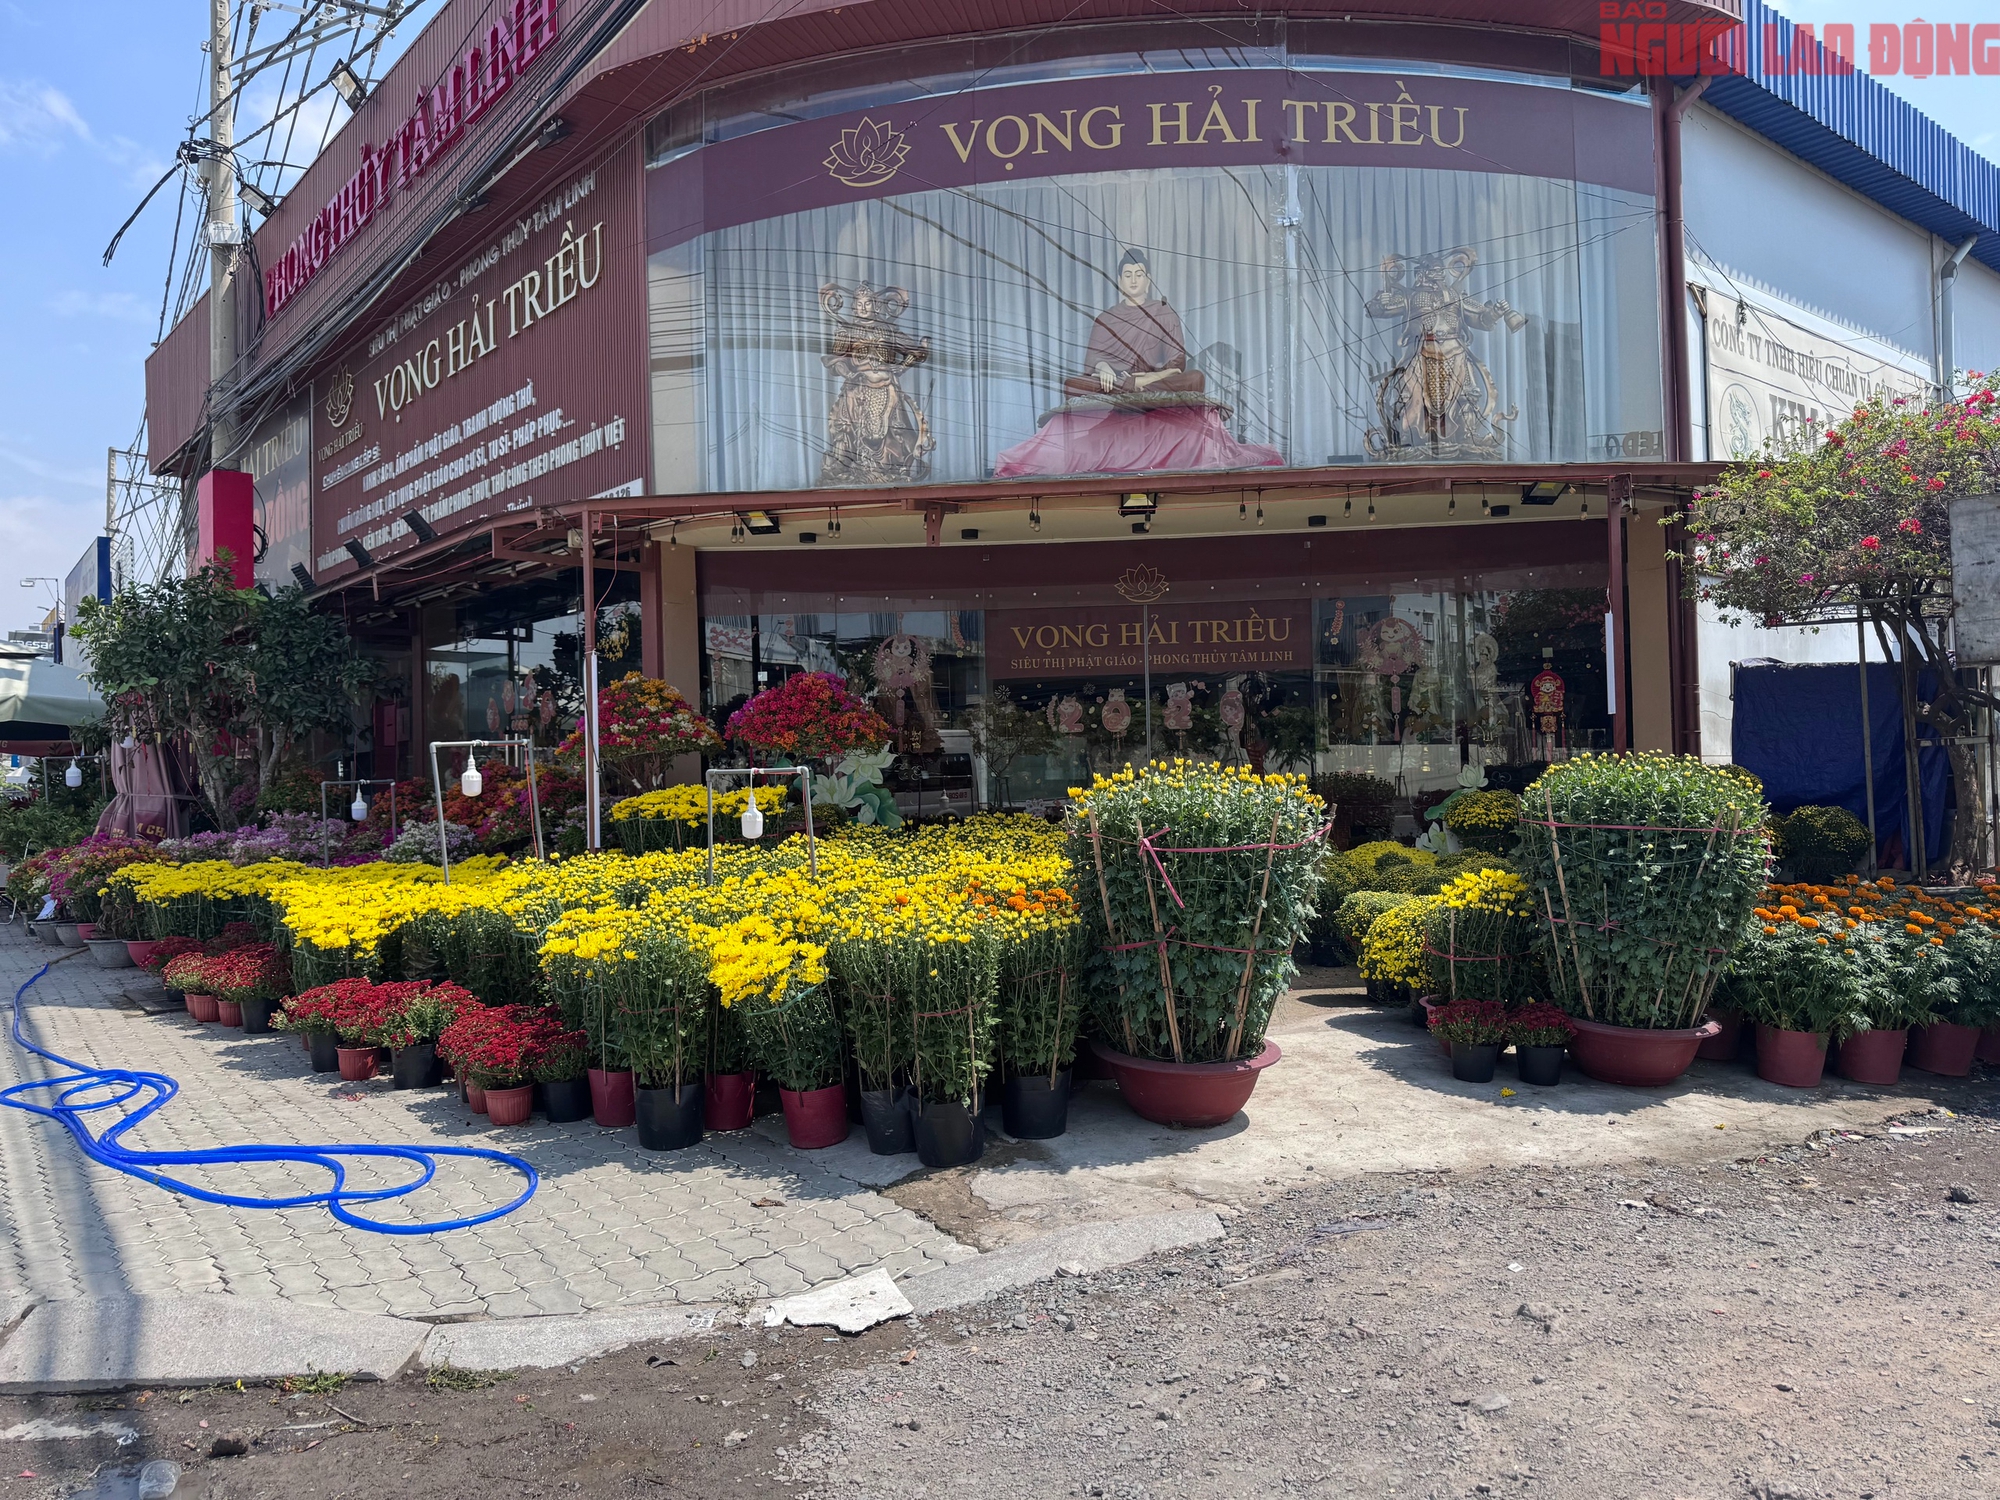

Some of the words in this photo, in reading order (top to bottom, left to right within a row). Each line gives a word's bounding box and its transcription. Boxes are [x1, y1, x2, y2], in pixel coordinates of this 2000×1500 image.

[266, 208, 331, 321] PHONG
[327, 143, 395, 252] THỦY
[394, 80, 465, 190] TÂM
[464, 0, 562, 124] LINH
[940, 105, 1125, 170] VỌNG
[1147, 85, 1262, 145] HẢI
[1283, 81, 1469, 148] TRIỀU
[423, 281, 451, 314] GIÁO
[459, 243, 500, 287] PHONG
[502, 219, 532, 256] THỦY
[533, 196, 562, 232] TÂM
[565, 171, 597, 209] LINH
[373, 337, 441, 423] VỌNG
[446, 293, 498, 378] HẢI
[503, 219, 604, 339] TRIỀU
[1712, 314, 1745, 356] CÔNG
[1747, 332, 1762, 363] TY
[1764, 339, 1796, 376] TNHH
[1797, 350, 1822, 388] HIỆU
[1859, 372, 1872, 401] VÀ
[263, 409, 304, 477] TRIỀU
[414, 471, 432, 498] PHẬT
[432, 464, 448, 489] GIÁO
[449, 457, 464, 481] CHO
[464, 448, 476, 473] CƯ
[488, 437, 499, 462] TU
[513, 418, 537, 450] PHÁP
[425, 433, 443, 460] PHẬT
[443, 423, 463, 450] GIÁO,
[462, 409, 489, 439] TRANH
[488, 394, 516, 425] TƯỢNG
[516, 379, 537, 411] THỜ,
[491, 466, 507, 495] THỜ
[507, 462, 529, 489] CÚNG
[528, 452, 550, 479] THEO
[550, 439, 580, 471] PHONG
[580, 422, 604, 458] THỦY
[604, 414, 626, 450] VIỆT
[1010, 624, 1110, 655] VỌNG
[1119, 614, 1180, 646] HẢI
[1188, 607, 1292, 644] TRIỀU
[1011, 655, 1041, 670] SIÊU
[1043, 657, 1065, 671] THỊ
[1068, 654, 1102, 669] PHẬT
[1104, 653, 1136, 668] GIÁO
[1192, 649, 1228, 665] THỦY
[1230, 649, 1258, 664] TÂM
[1260, 651, 1294, 663] LINH
